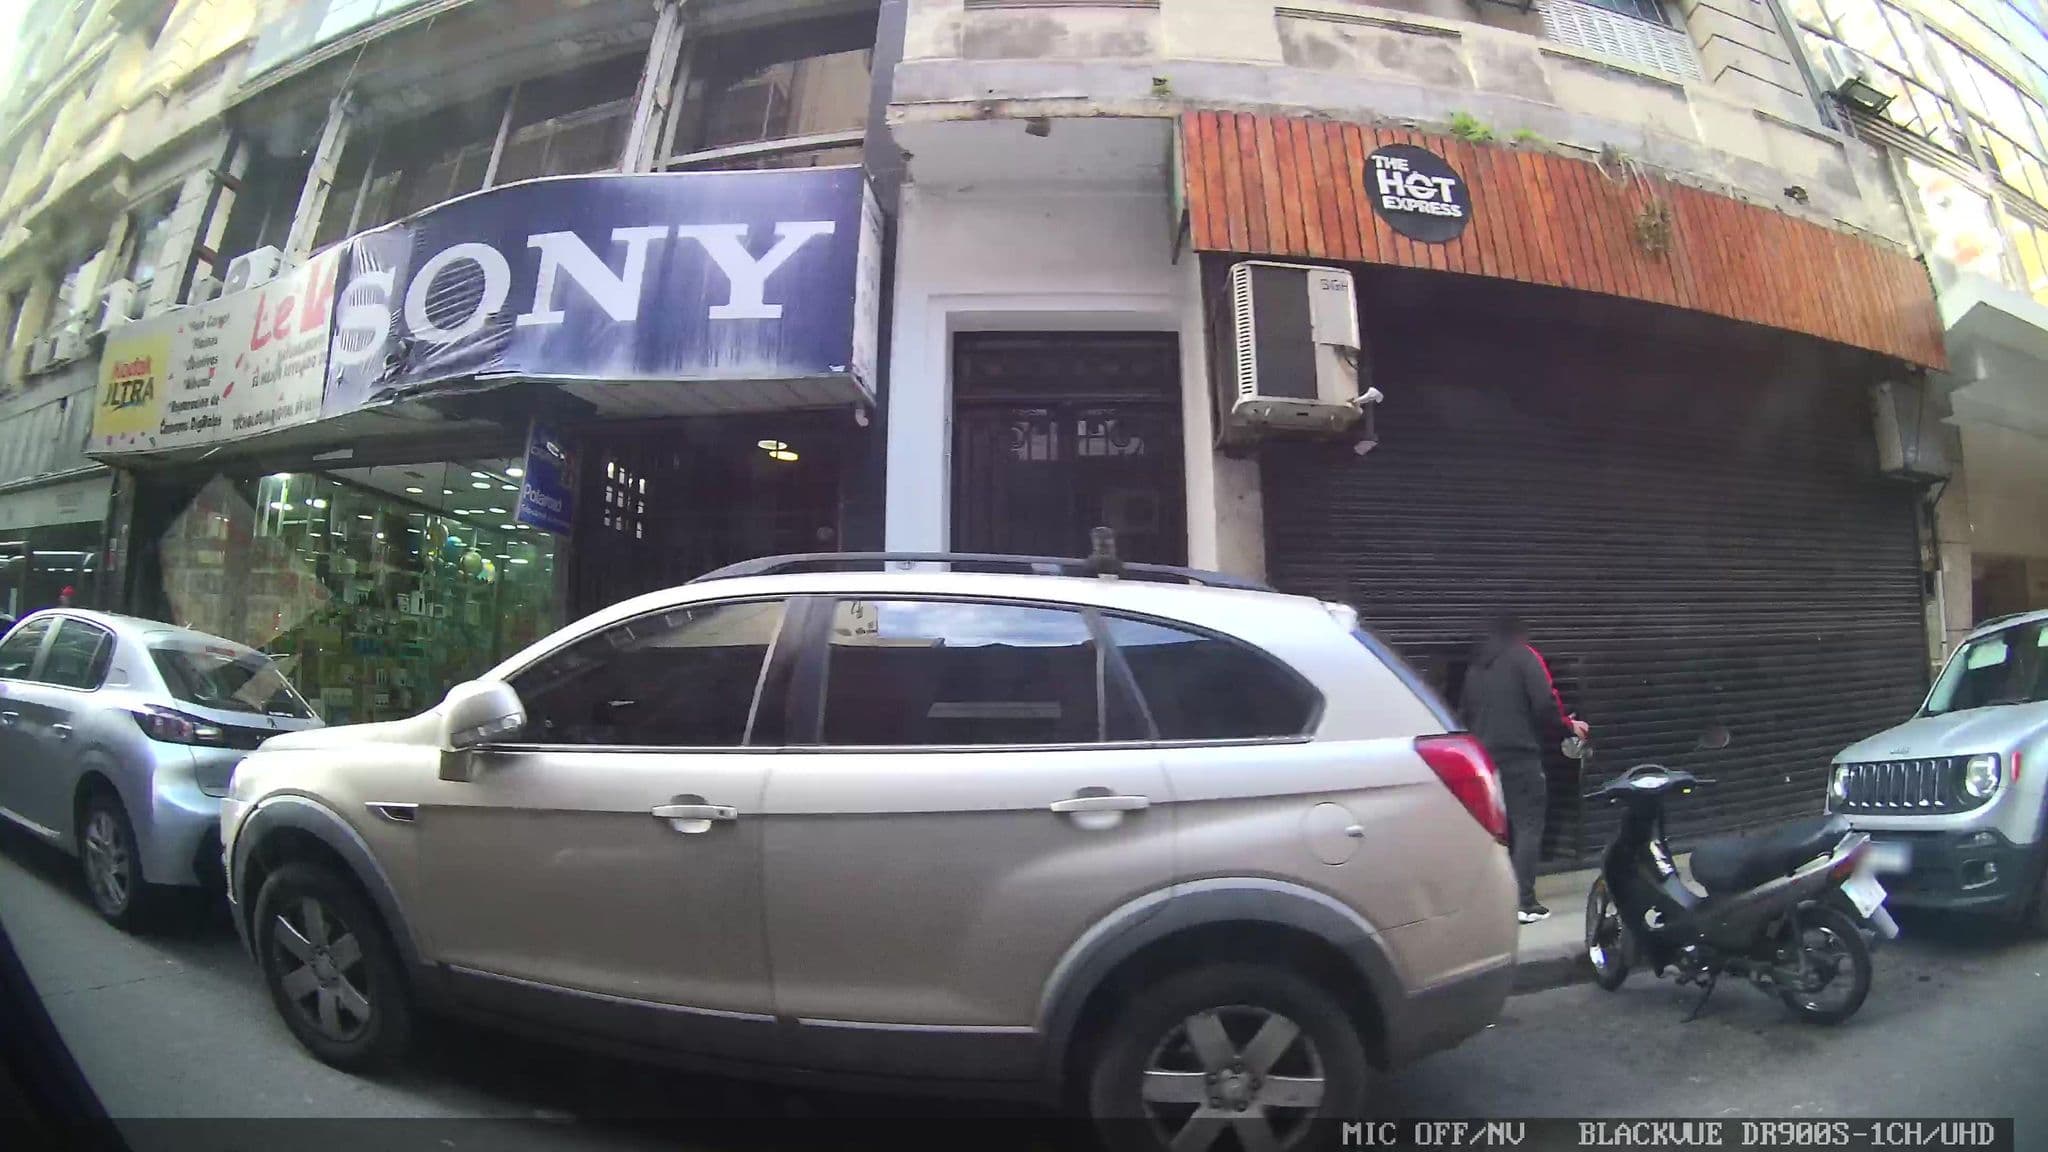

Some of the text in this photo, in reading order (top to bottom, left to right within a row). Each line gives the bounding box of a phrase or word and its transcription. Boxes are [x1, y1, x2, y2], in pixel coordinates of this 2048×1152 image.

[1371, 154, 1409, 171] THE
[1376, 170, 1456, 203] HOT
[1382, 195, 1463, 217] EXPRESS
[335, 220, 837, 366] SONY
